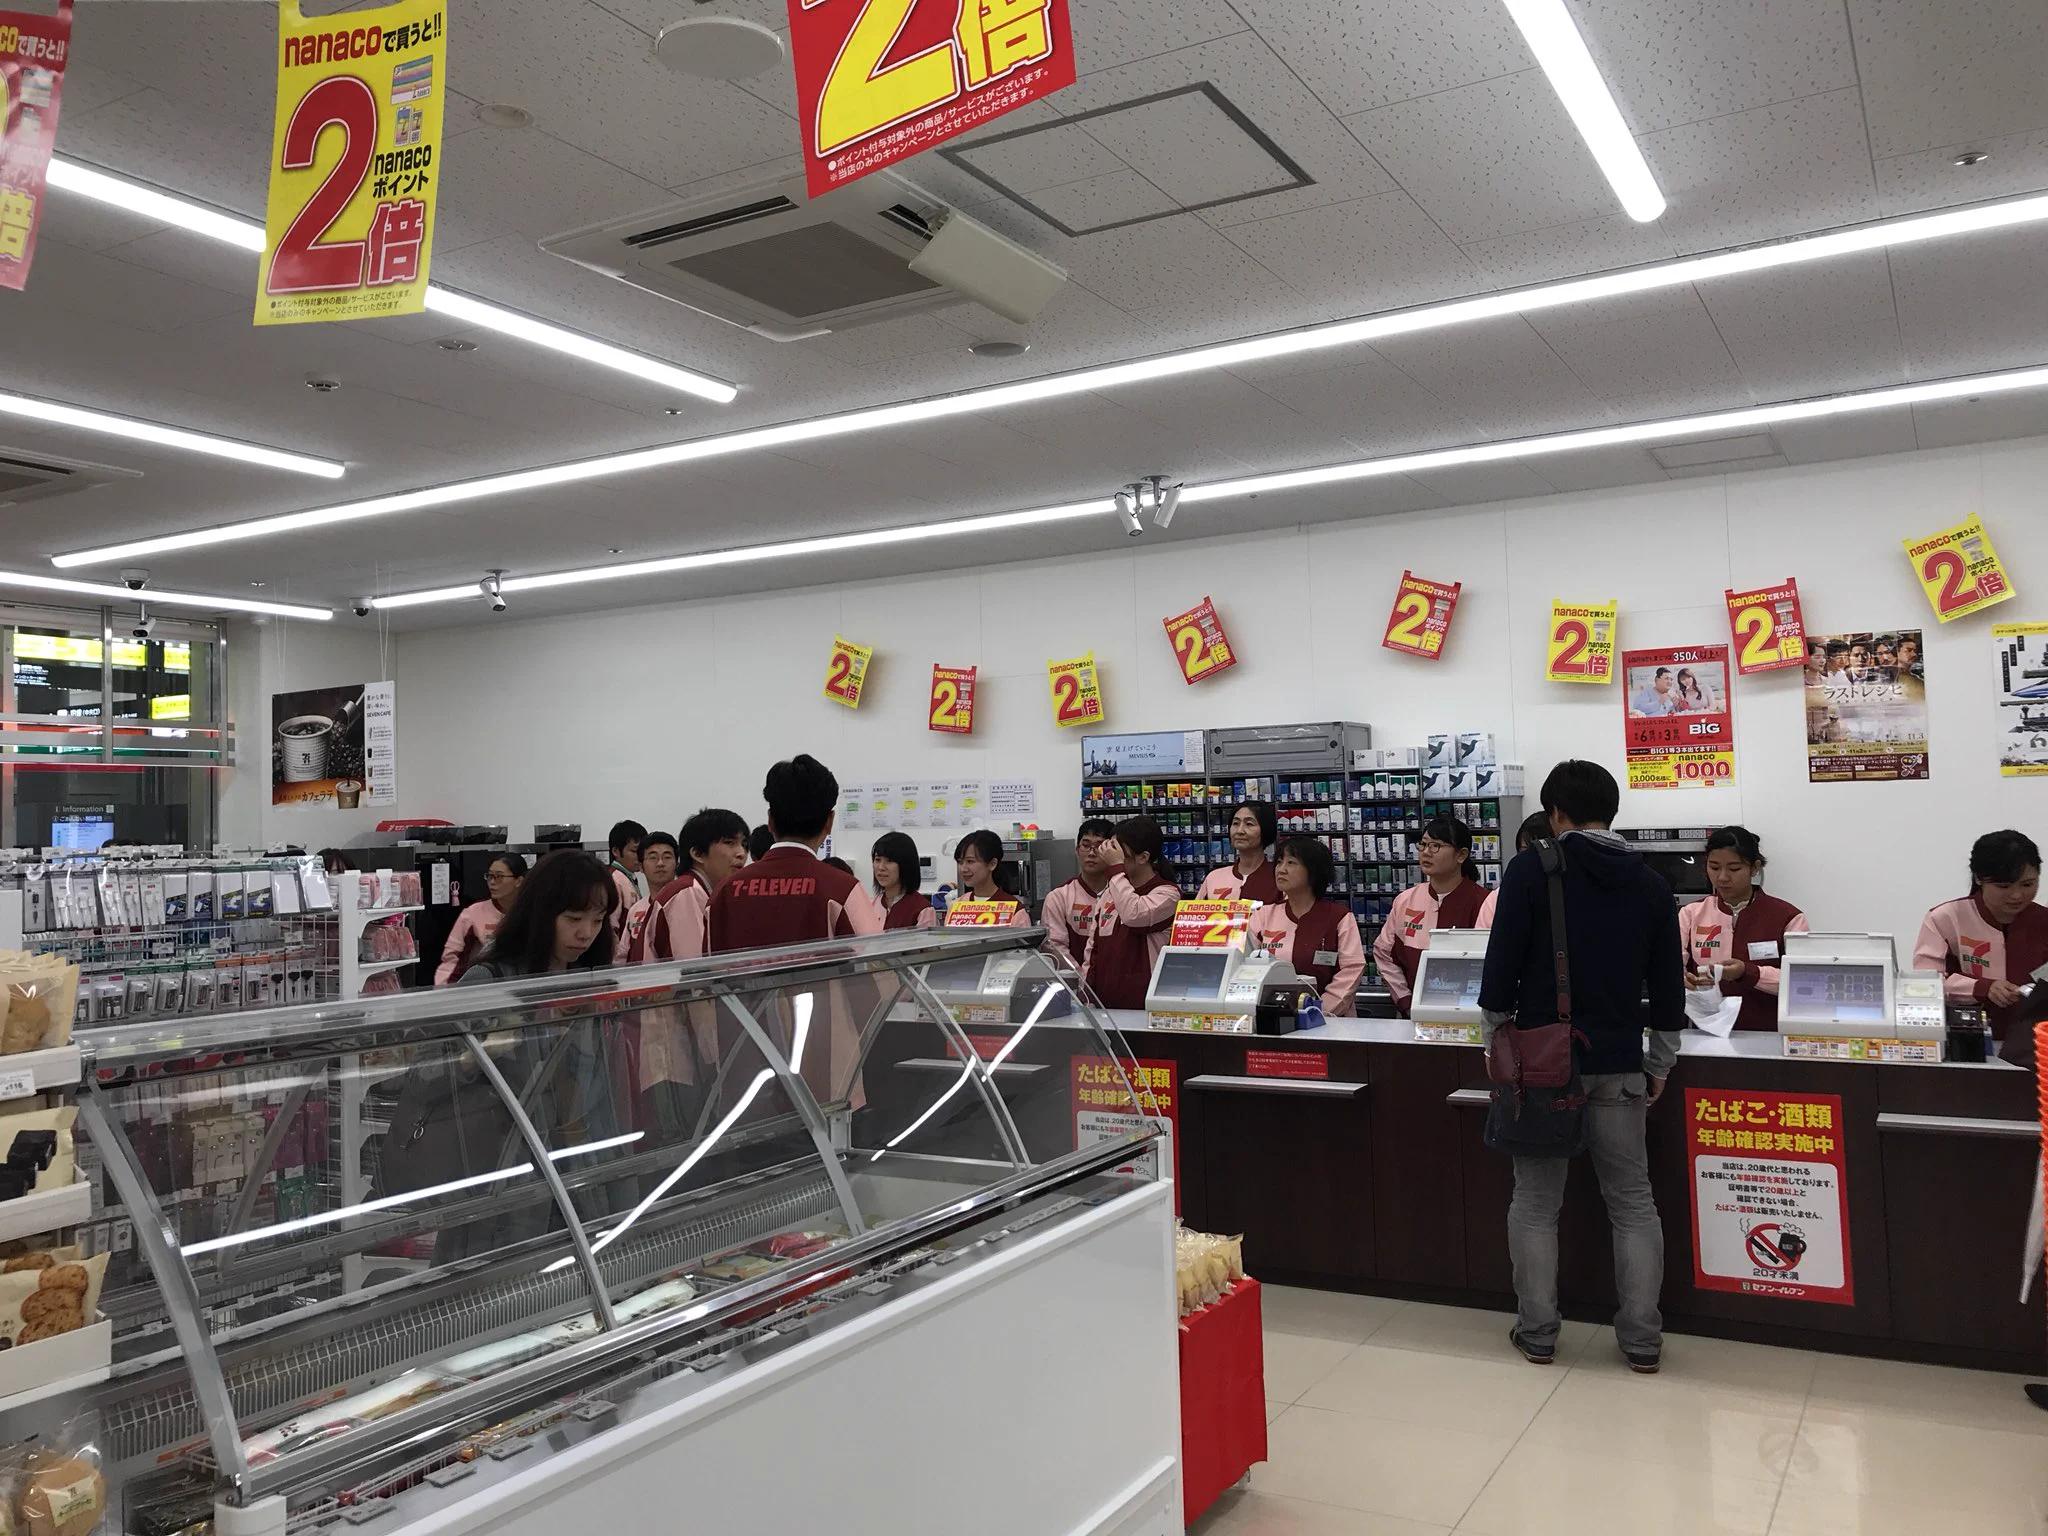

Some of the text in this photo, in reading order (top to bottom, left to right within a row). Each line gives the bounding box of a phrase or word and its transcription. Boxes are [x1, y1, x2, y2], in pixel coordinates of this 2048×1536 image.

[375, 145, 434, 186] nanaco
[374, 174, 431, 200] ポイント
[1966, 556, 1995, 571] nanaco
[1689, 721, 1721, 736] BIG
[732, 877, 817, 895] 7-ELEVEN
[1696, 1098, 1833, 1129] たばこ・酒類
[1697, 1128, 1835, 1154] 年齢確認実施中
